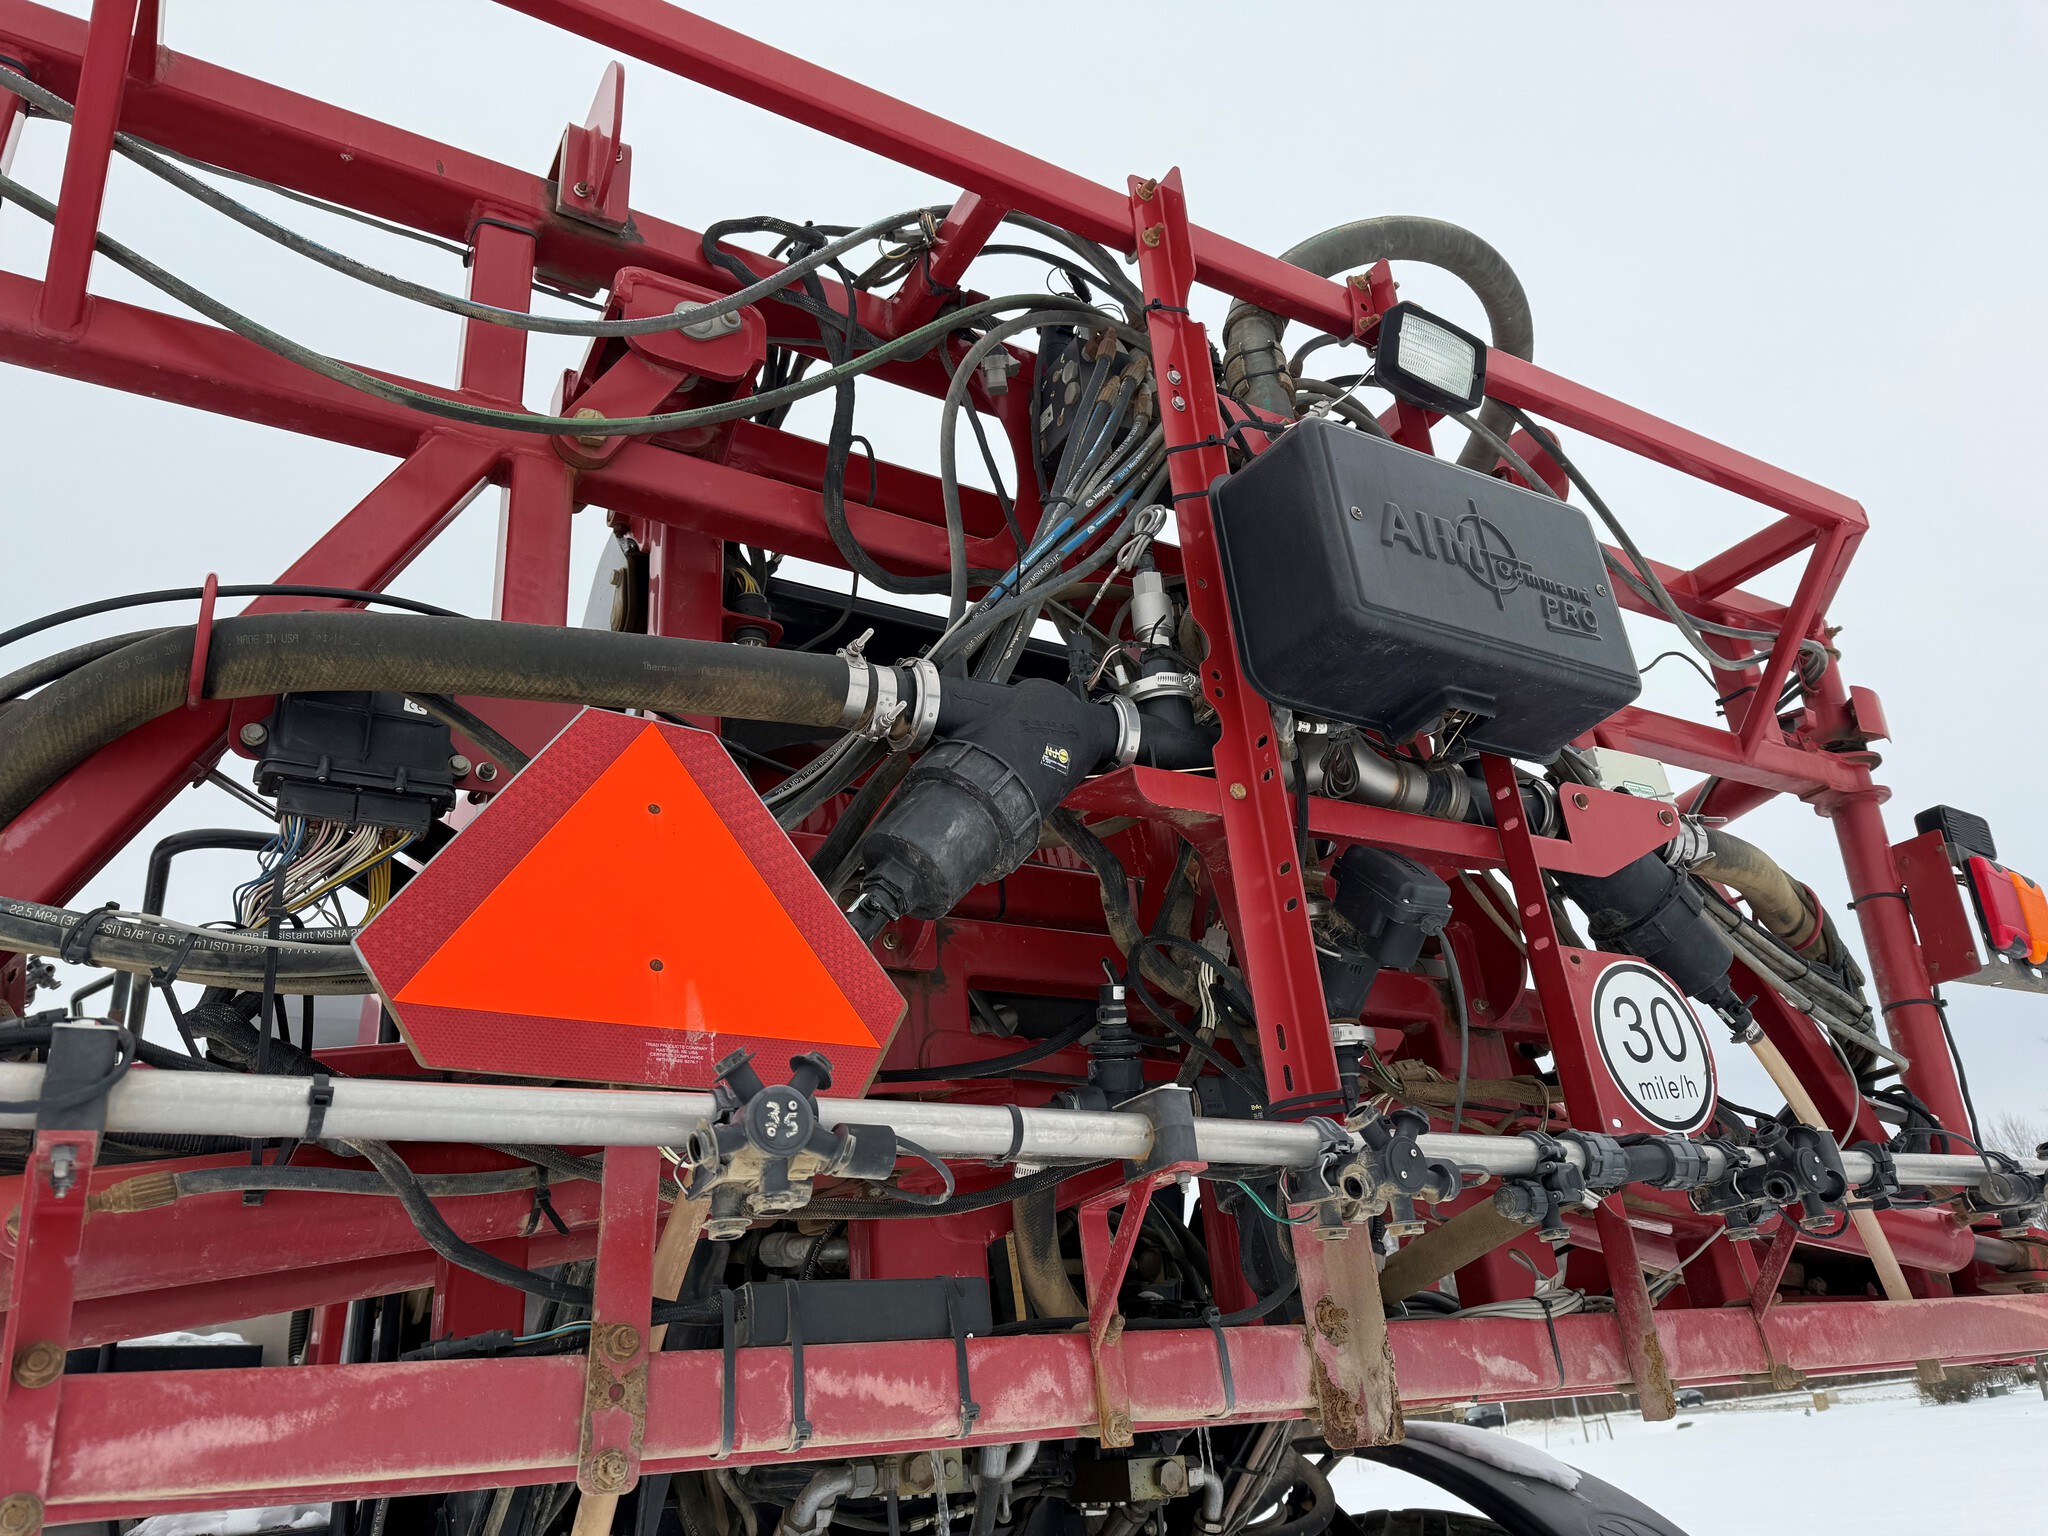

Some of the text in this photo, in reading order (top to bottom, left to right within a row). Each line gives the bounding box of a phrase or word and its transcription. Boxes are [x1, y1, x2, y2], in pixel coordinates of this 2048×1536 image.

[1381, 501, 1484, 574] AIM
[1540, 595, 1599, 633] PRO
[236, 634, 260, 644] MADE
[266, 634, 277, 643] IN
[281, 633, 299, 644] USA
[9, 904, 32, 917] 22.5
[34, 910, 57, 923] MPa
[262, 930, 314, 940] Rsistant
[317, 928, 348, 938] MSHA
[1613, 996, 1687, 1063] 30
[1638, 1074, 1699, 1101] mile/h
